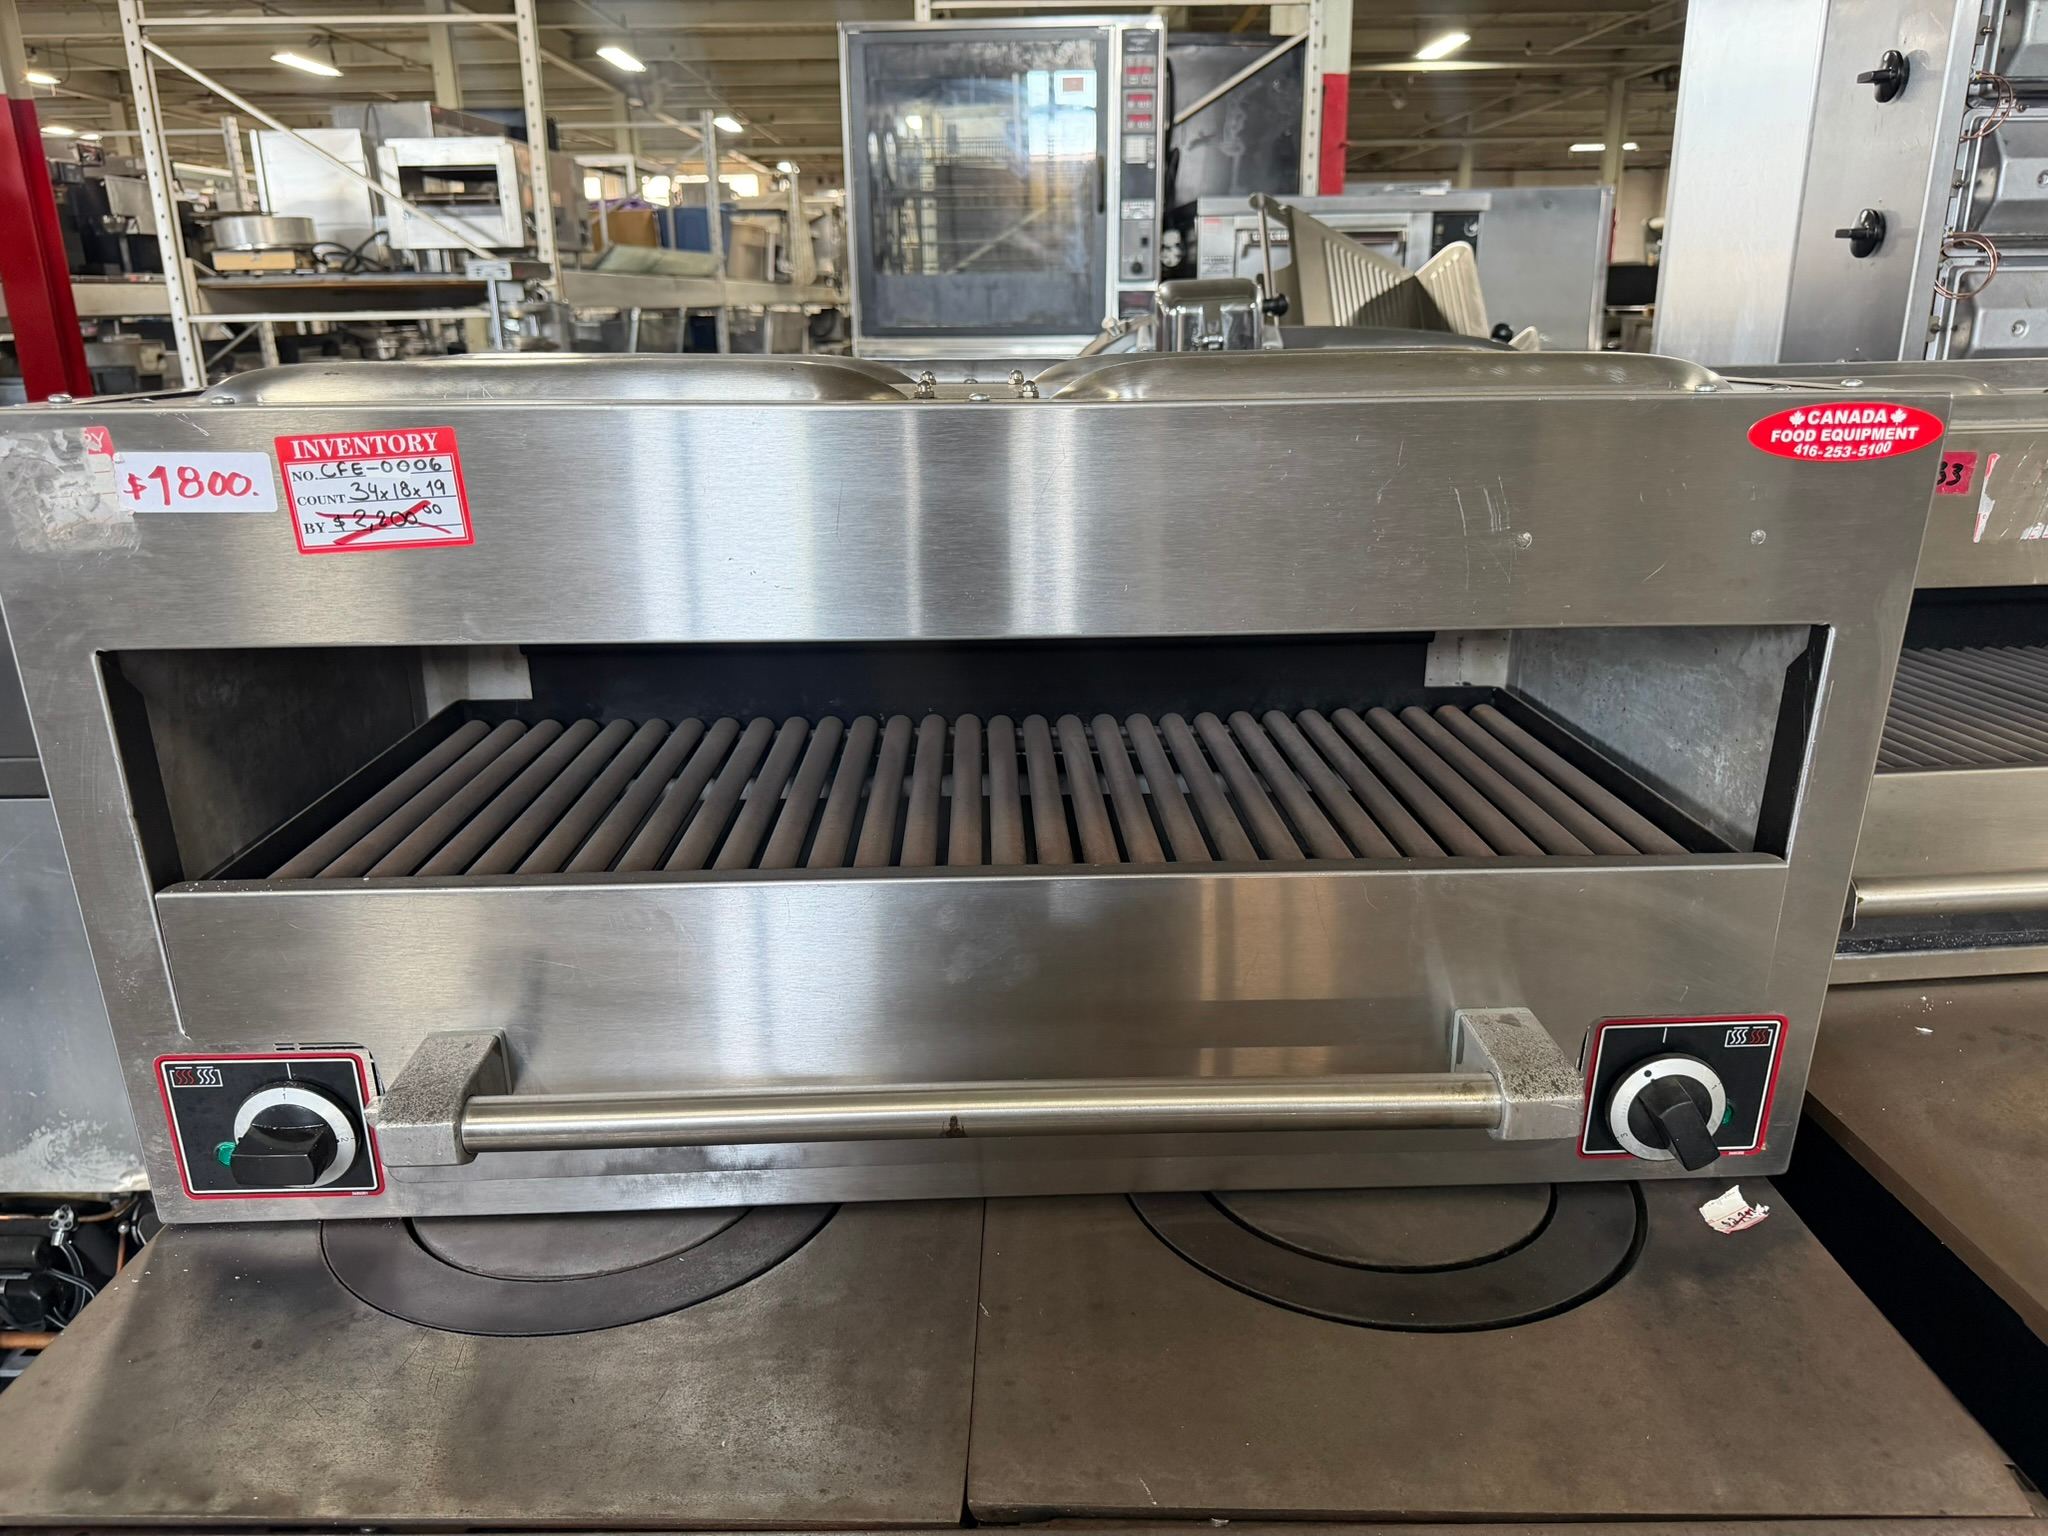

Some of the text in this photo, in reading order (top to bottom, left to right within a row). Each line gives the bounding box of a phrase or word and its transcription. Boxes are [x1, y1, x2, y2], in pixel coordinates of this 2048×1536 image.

[1807, 409, 1887, 426] CANADA
[1770, 427, 1919, 443] FOOD EQUIPMENT
[292, 432, 438, 459] INVENTORY
[1793, 441, 1892, 458] 416-253-5100
[292, 458, 442, 482] NO. CFE-0006
[297, 494, 346, 506] COUNT
[304, 522, 325, 535] BY
